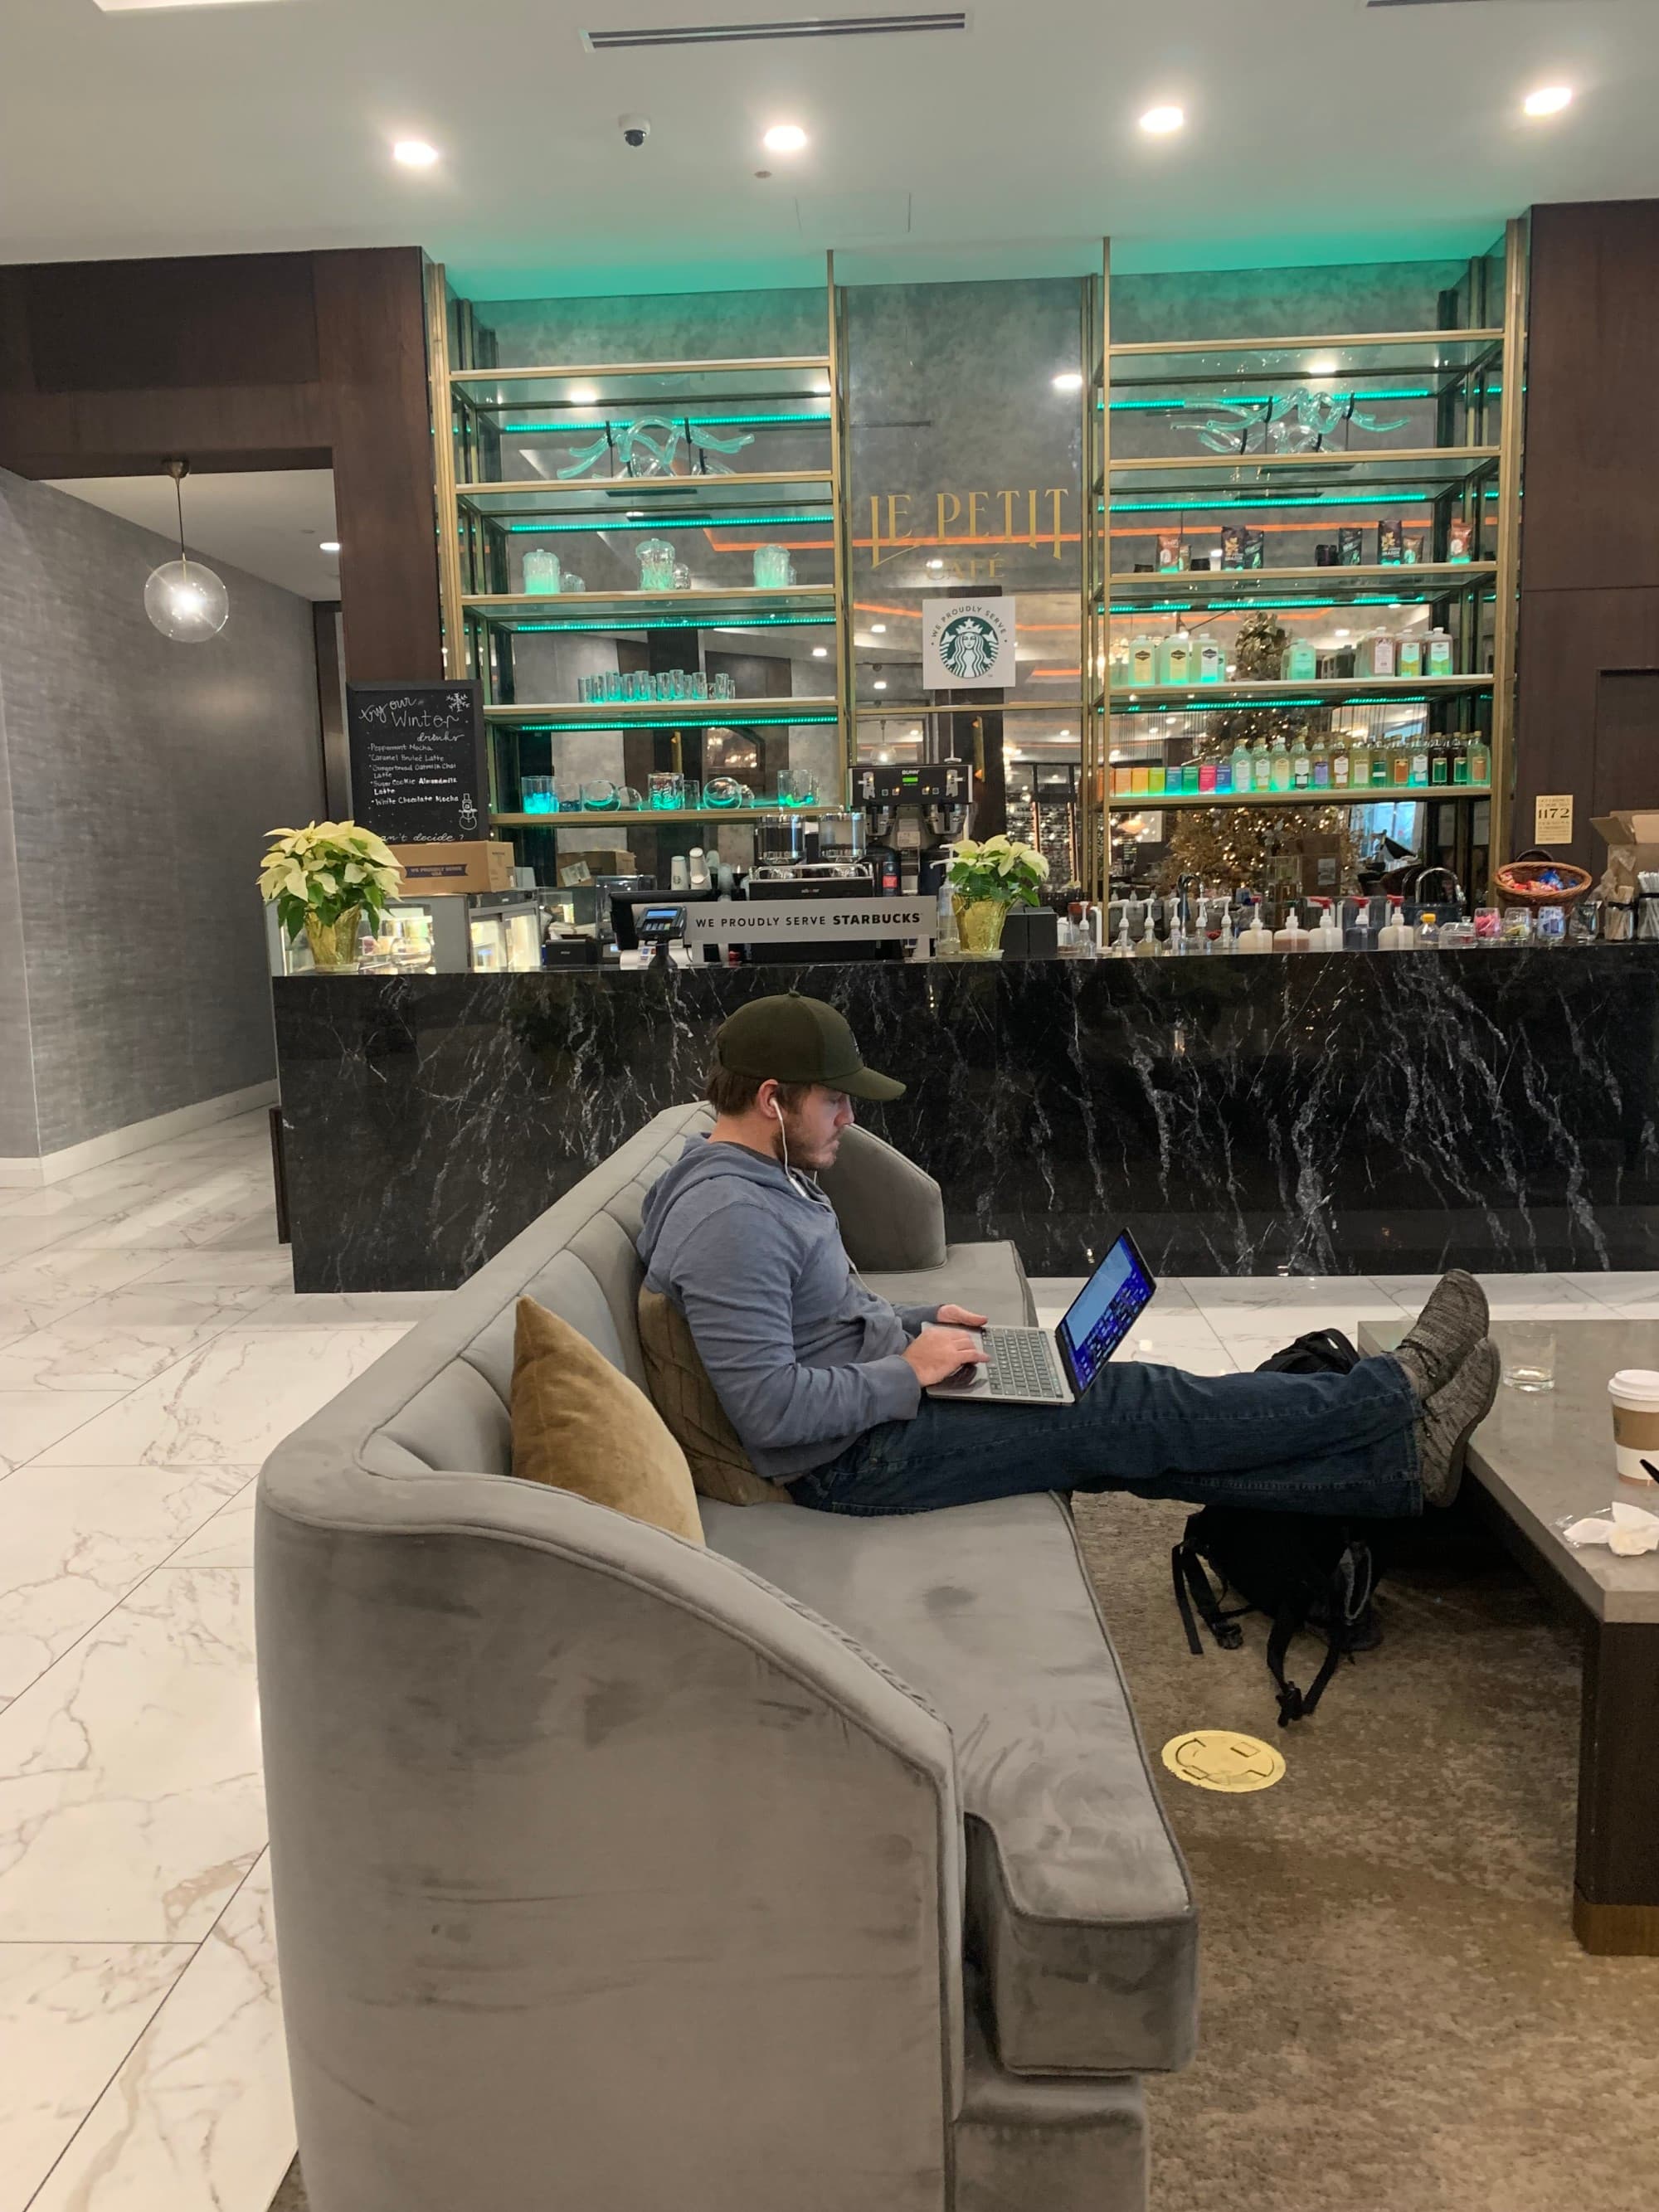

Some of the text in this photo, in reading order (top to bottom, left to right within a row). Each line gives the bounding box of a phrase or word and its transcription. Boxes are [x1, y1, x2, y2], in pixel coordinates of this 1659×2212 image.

[936, 488, 1069, 560] PETIT
[932, 605, 1006, 638] WE PROUDLY SERVE
[358, 697, 417, 723] try our
[391, 709, 460, 728] Winter
[416, 731, 465, 742] drinks
[371, 753, 399, 761] Caramel
[425, 754, 445, 762] Latte
[373, 771, 393, 780] Latte
[373, 787, 396, 796] Latte
[435, 795, 460, 803] Mocha
[1538, 808, 1570, 819] 1172
[412, 833, 455, 843] decide
[695, 912, 922, 928] WE PROUDLY SERVE STARBUCKS
